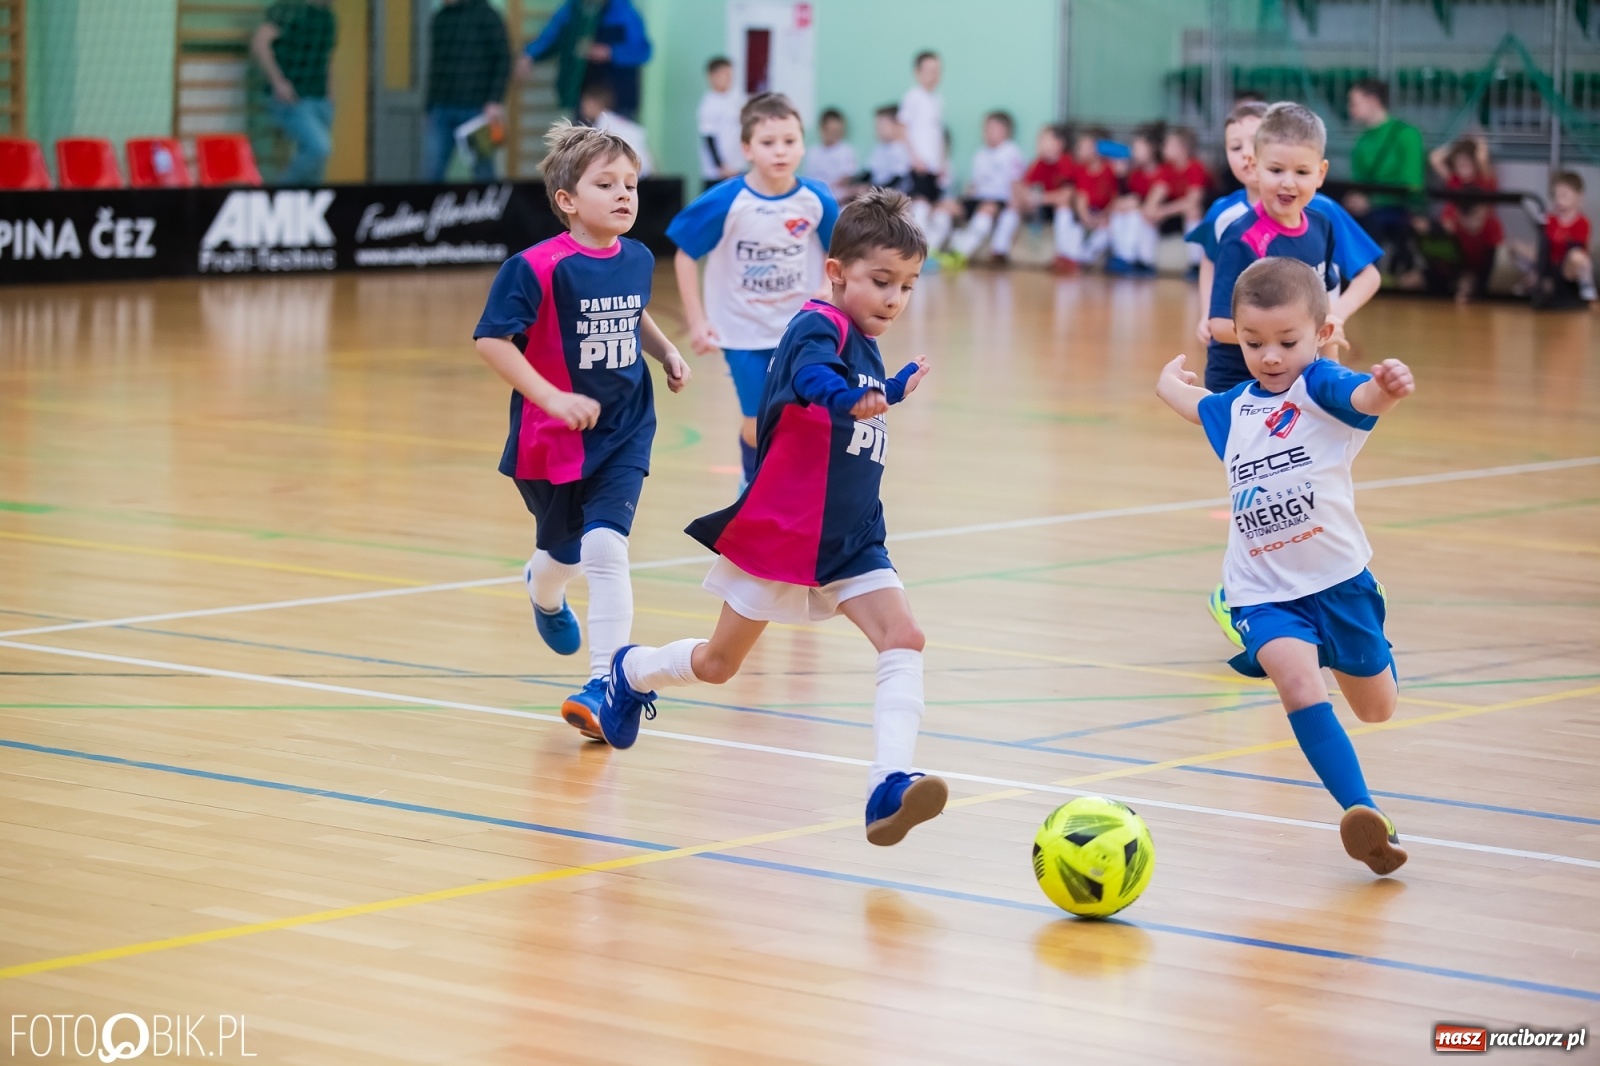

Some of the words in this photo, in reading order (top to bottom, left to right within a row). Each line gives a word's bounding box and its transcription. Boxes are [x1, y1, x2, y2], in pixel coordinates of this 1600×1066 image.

[0, 218, 82, 260] PINA
[89, 206, 157, 259] ČEZ
[201, 190, 337, 248] AMK
[580, 294, 641, 313] PAWILON
[576, 316, 640, 335] MEBLOW
[579, 336, 637, 370] PIK
[1255, 481, 1312, 506] BESKID
[1235, 491, 1315, 533] ENERGY
